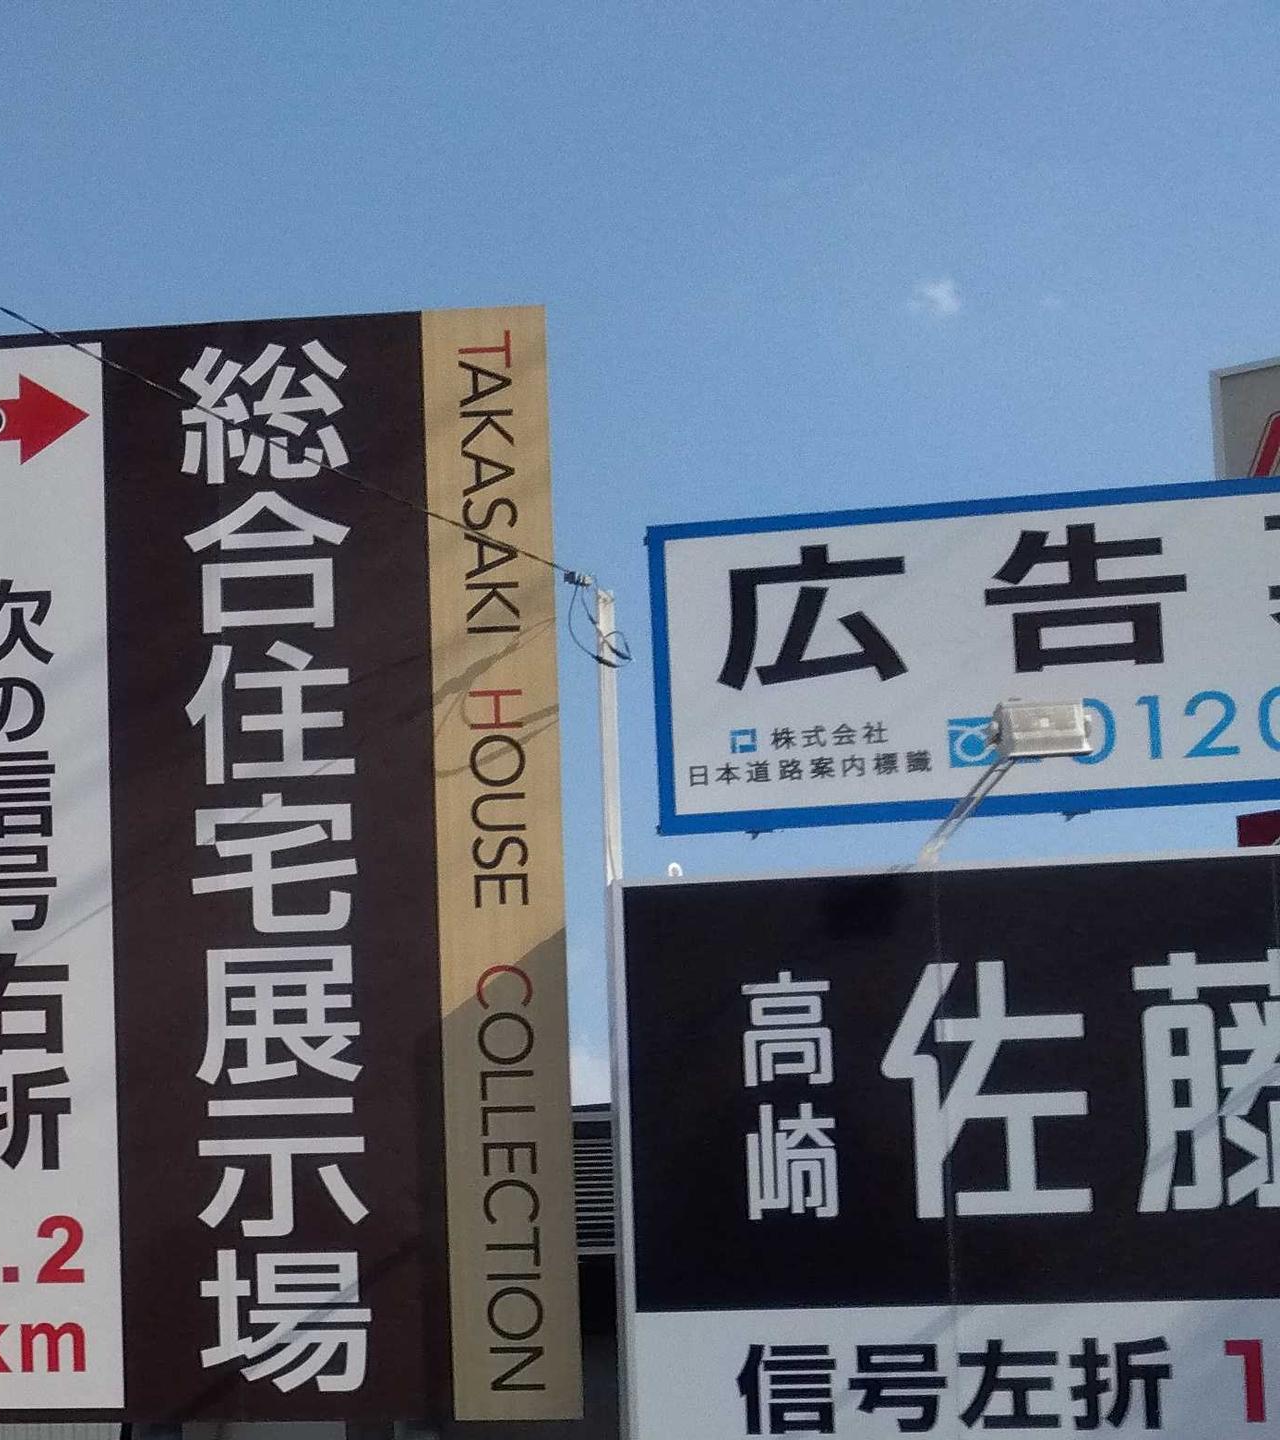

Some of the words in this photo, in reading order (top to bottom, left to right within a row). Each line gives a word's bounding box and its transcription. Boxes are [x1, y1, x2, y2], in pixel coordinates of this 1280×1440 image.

[456, 329, 523, 635] TAKASAKI
[716, 513, 1280, 691] 広告
[467, 688, 530, 908] HOUSE
[688, 749, 933, 787] 日本道路案内標識
[770, 721, 889, 750] 株式会社
[180, 338, 372, 1394] 総合住宅展示場
[476, 963, 547, 1394] COLLECTION
[740, 969, 840, 1220] 高崎
[736, 1334, 1174, 1435] 信号左折
